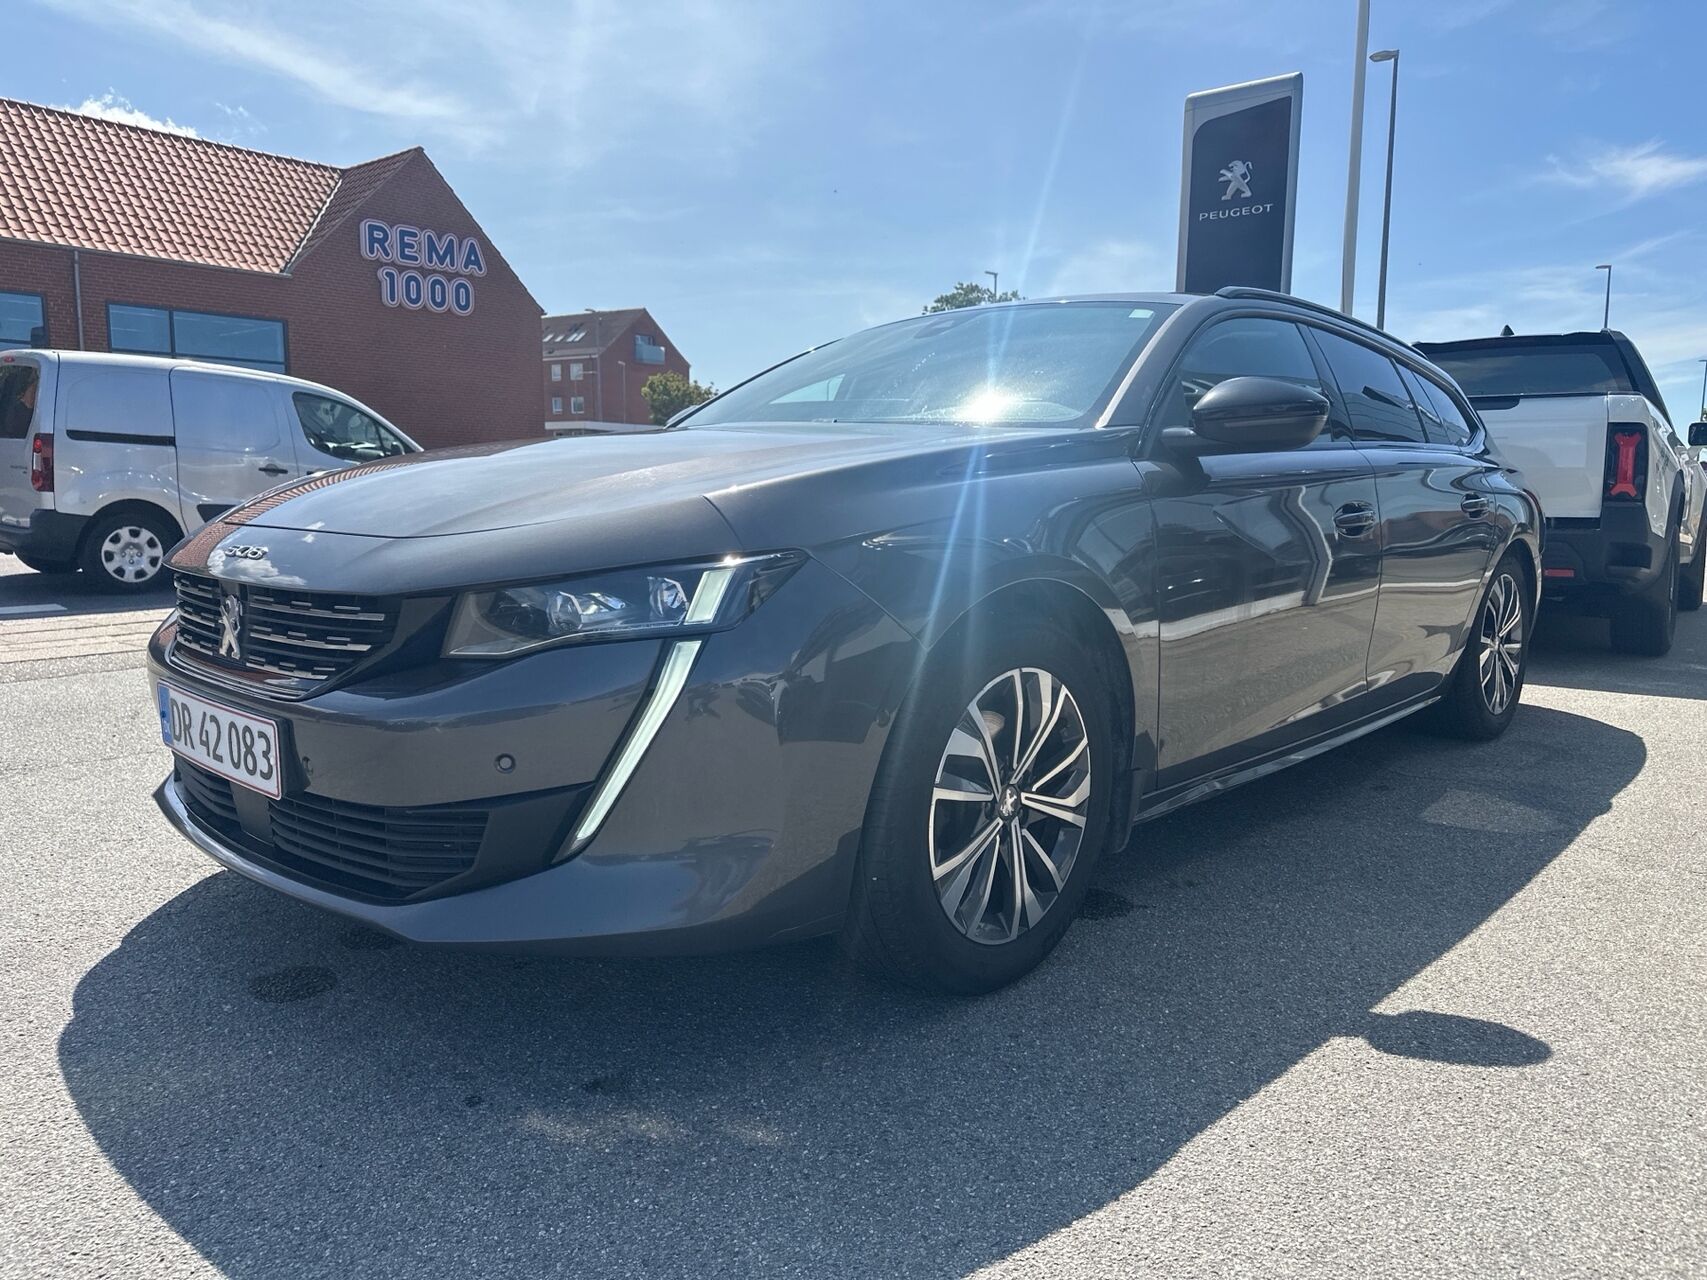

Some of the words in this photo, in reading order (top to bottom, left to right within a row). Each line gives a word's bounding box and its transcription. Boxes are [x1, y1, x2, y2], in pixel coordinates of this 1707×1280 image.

[1199, 203, 1274, 221] PEUGEOT
[361, 219, 486, 276] REMA
[378, 267, 473, 315] 1000
[170, 698, 195, 750] DR
[199, 711, 224, 764] 42
[228, 720, 273, 781] 083
